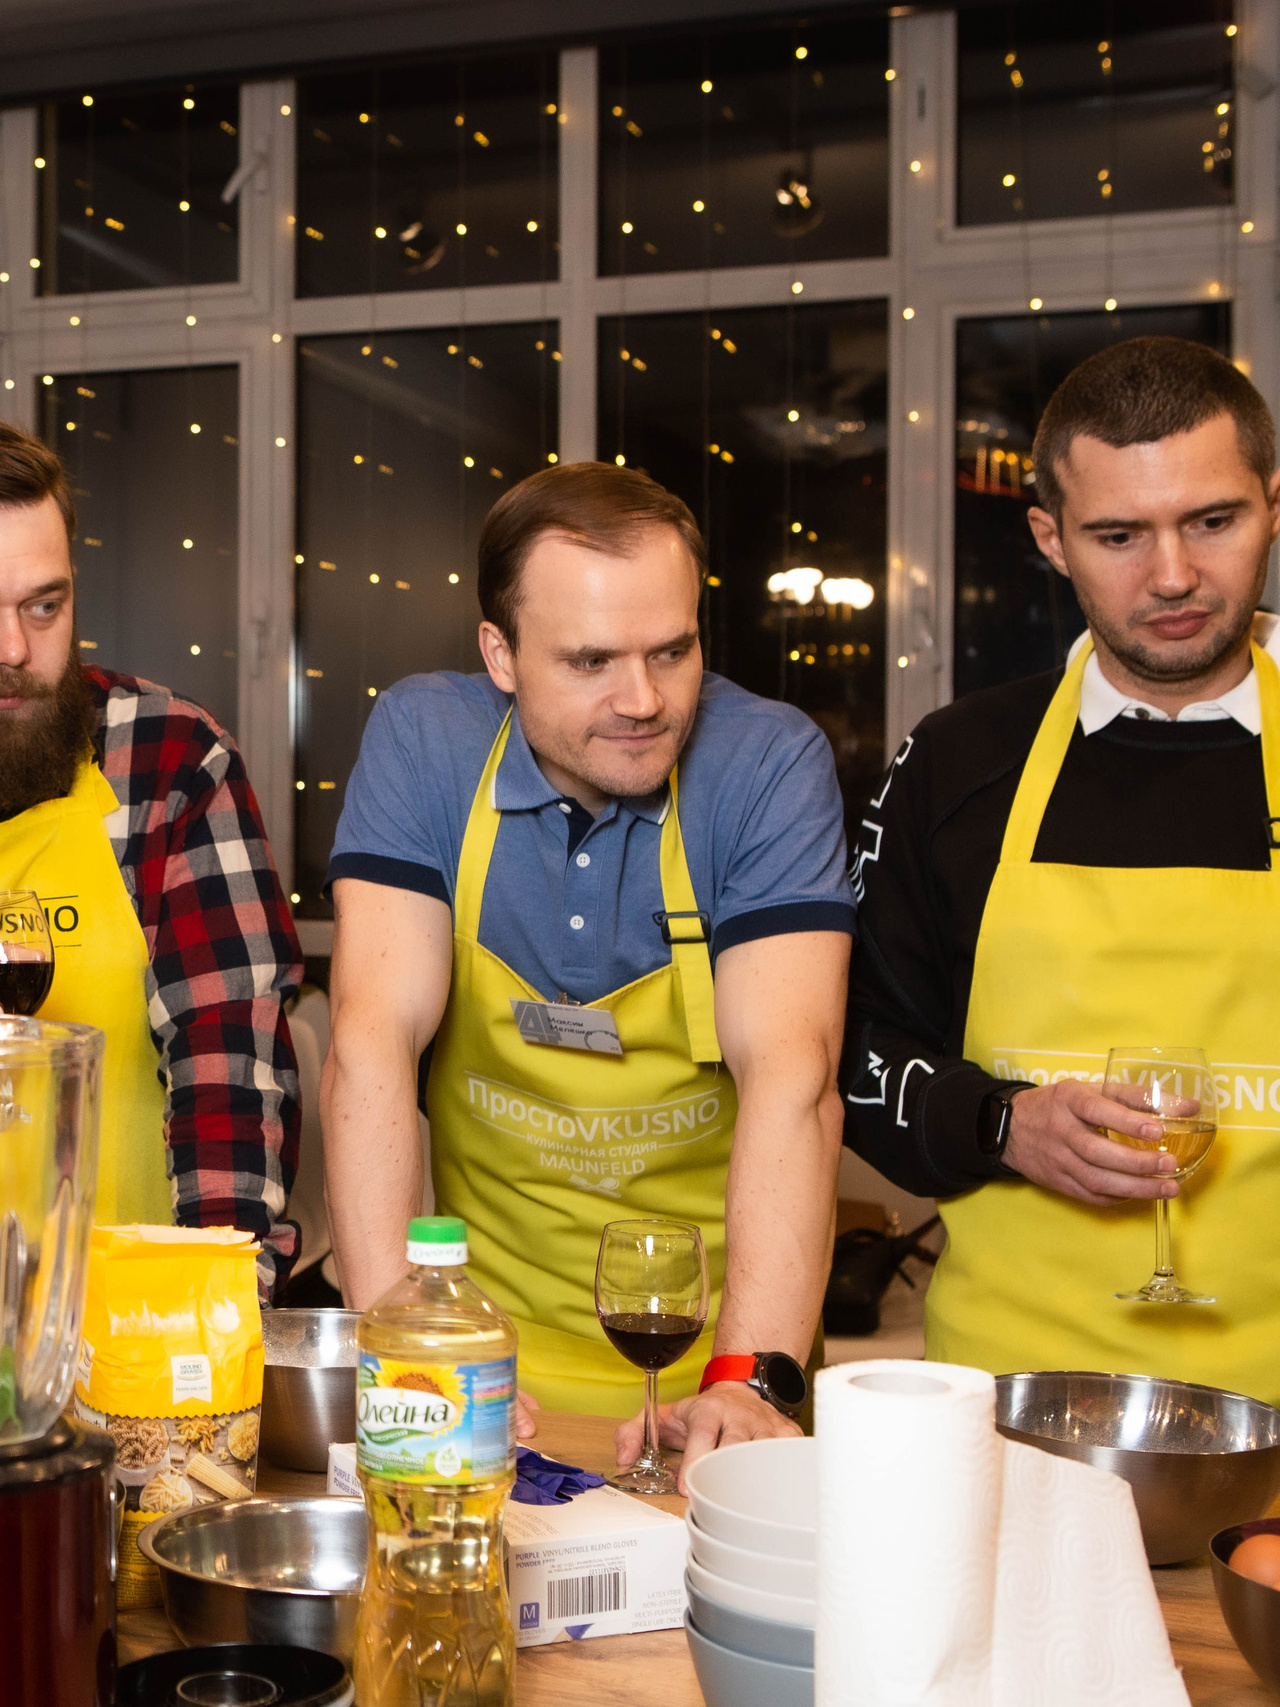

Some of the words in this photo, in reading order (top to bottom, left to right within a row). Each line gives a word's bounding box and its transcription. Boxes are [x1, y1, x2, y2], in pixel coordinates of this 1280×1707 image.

[468, 1077, 720, 1143] ПростоVKUSNO
[526, 1132, 606, 1158] КУЛИНАРНАЯ
[608, 1141, 658, 1158] СТУДИЯ
[539, 1152, 645, 1176] MAUNFELD
[358, 1392, 449, 1424] Олейна
[515, 1551, 540, 1561] PURPLE
[590, 1542, 612, 1553] BLEND
[612, 1539, 639, 1548] GLOVES
[515, 1560, 542, 1569] POWDER
[523, 1605, 536, 1620] M
